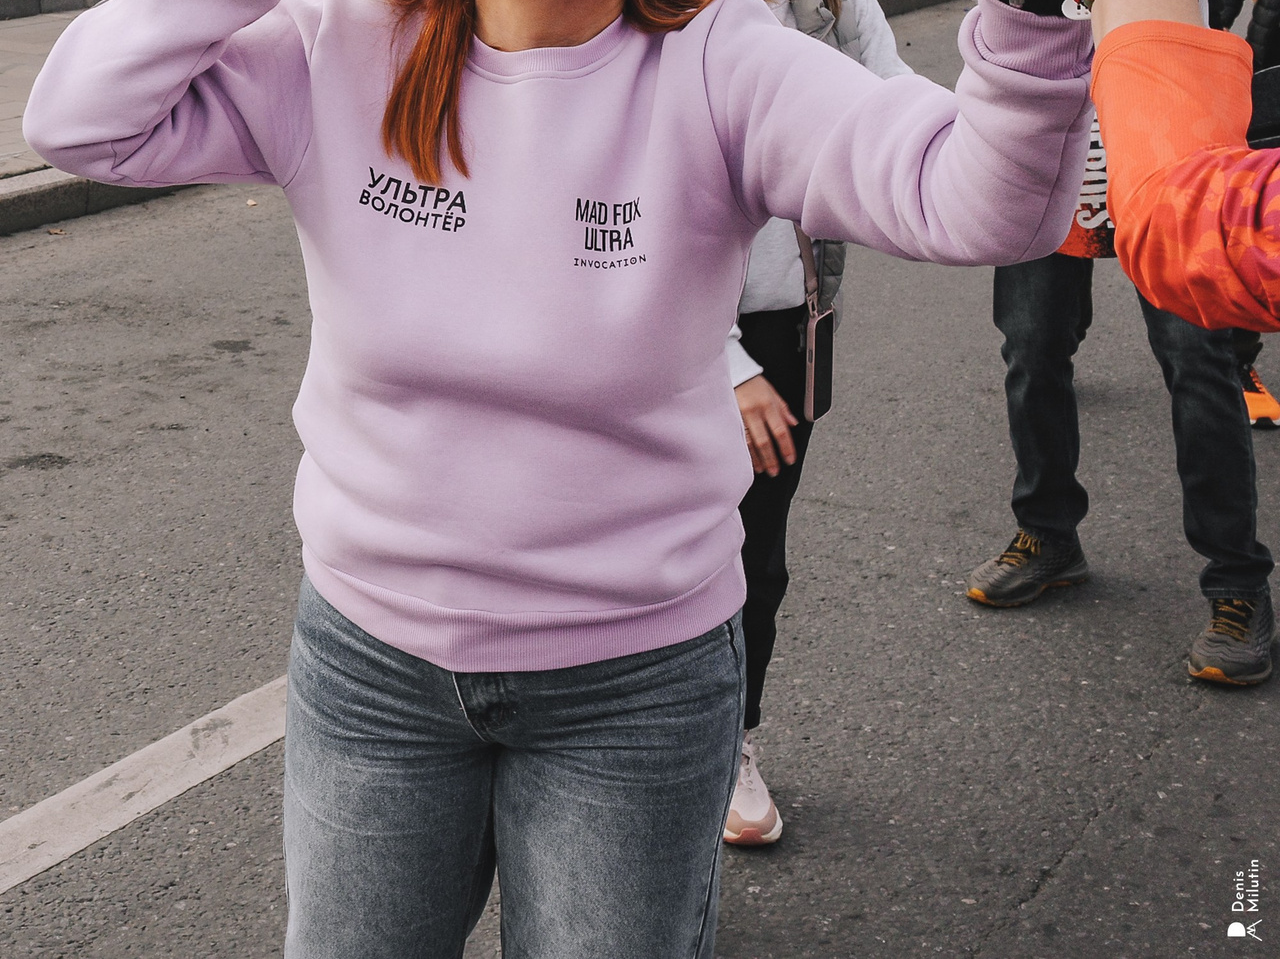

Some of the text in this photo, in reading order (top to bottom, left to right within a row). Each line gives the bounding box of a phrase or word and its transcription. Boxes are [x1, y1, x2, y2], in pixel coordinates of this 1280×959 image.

[368, 166, 467, 213] УЛЬТРА
[359, 188, 466, 233] ВОЛОНТЁР
[575, 196, 642, 226] MAD FOX
[584, 226, 634, 252] ULTRA
[573, 254, 647, 270] INVOCATION
